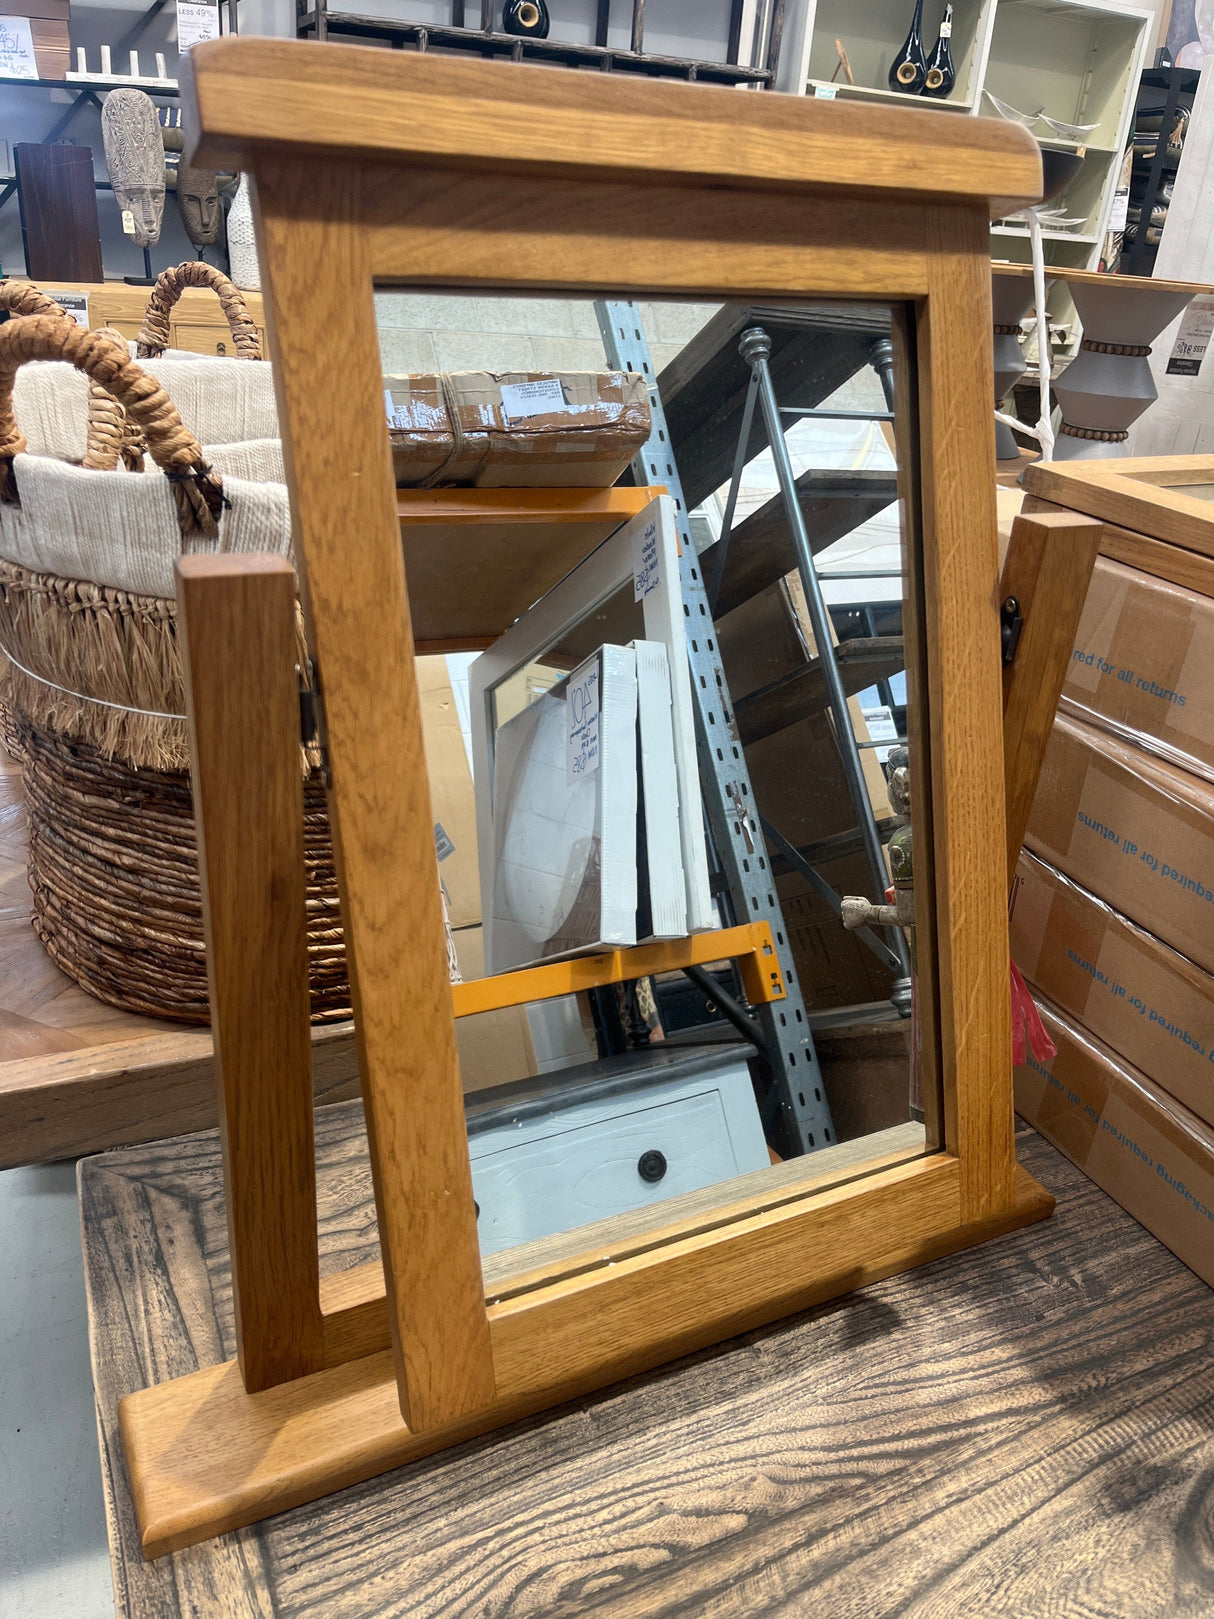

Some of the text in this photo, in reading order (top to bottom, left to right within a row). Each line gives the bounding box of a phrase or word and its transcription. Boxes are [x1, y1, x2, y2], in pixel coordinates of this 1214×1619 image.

[1096, 657, 1115, 675] for
[1117, 669, 1134, 684] all
[1136, 677, 1187, 707] returns
[1078, 811, 1214, 904] equired for all returns
[1067, 949, 1205, 1056] required for all returns
[1026, 1056, 1214, 1223] ackaging required for all returns
